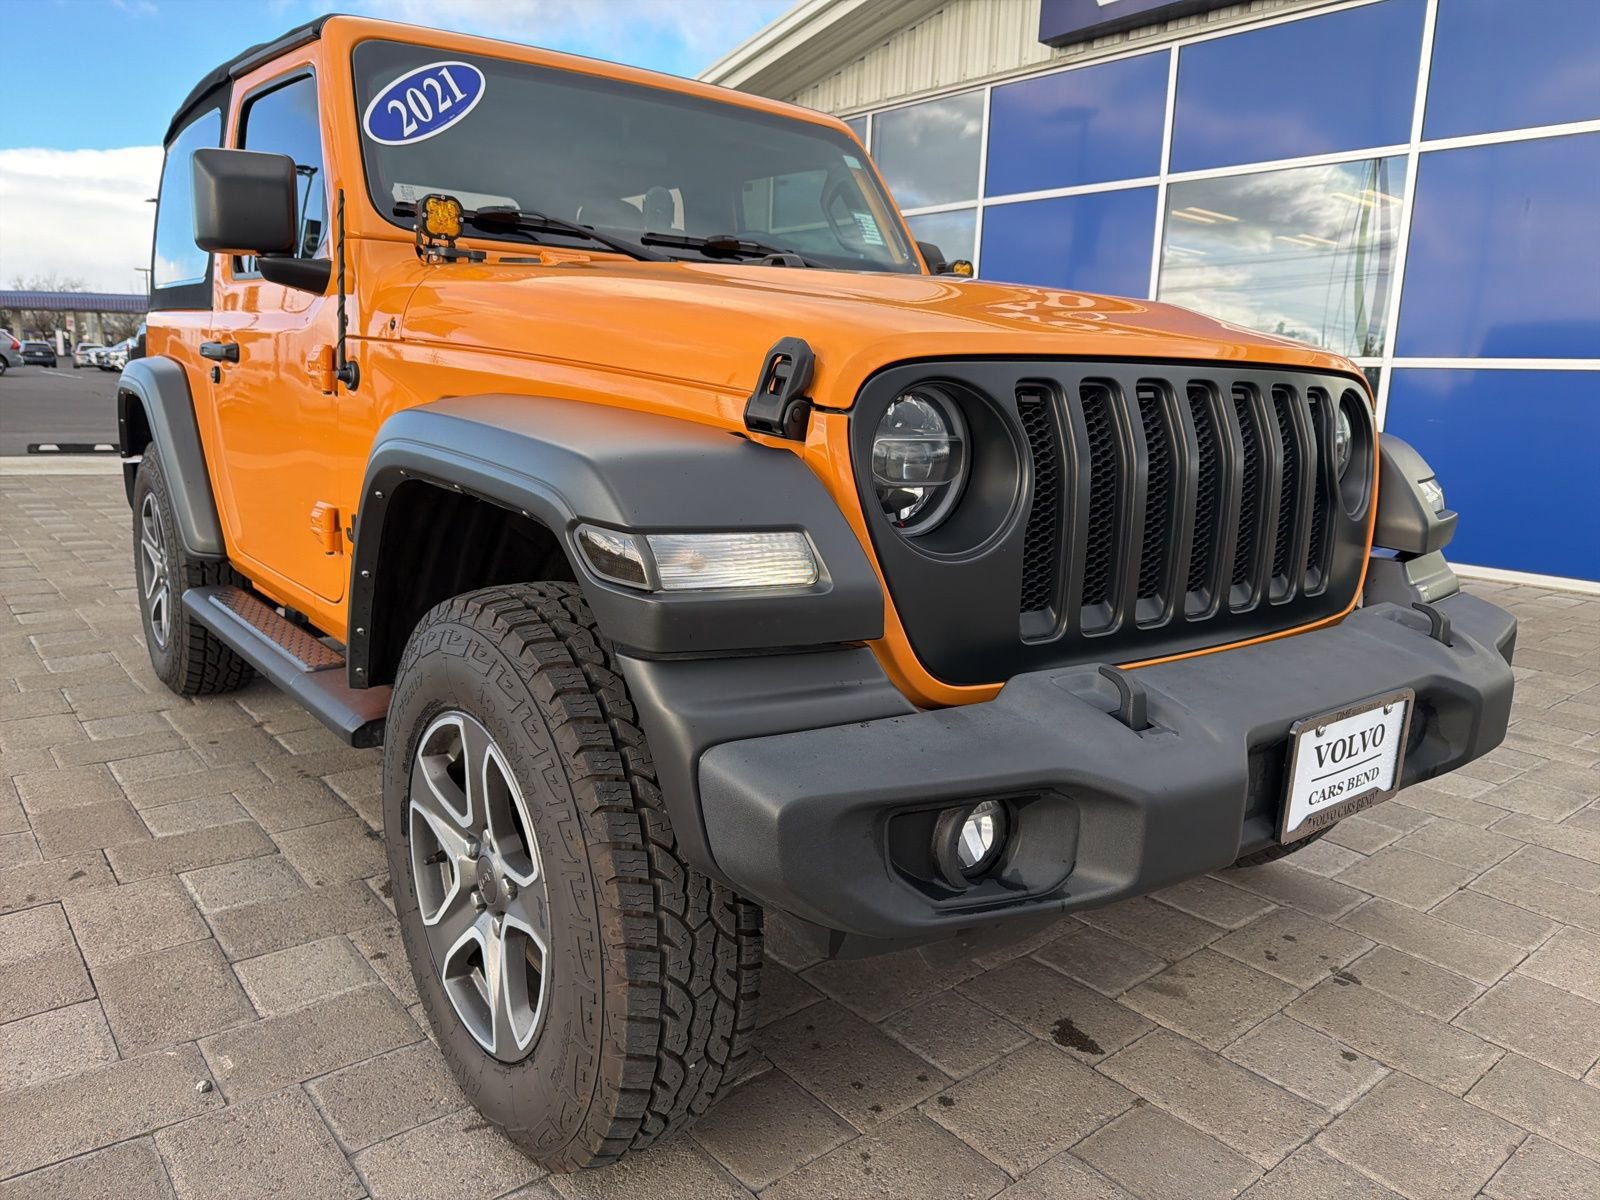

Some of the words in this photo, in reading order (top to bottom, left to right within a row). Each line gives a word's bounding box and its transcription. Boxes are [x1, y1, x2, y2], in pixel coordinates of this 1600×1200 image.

[387, 67, 467, 138] 2021
[1314, 723, 1386, 768] VOLVO
[1308, 781, 1345, 806] CARS
[1346, 766, 1380, 792] BEND
